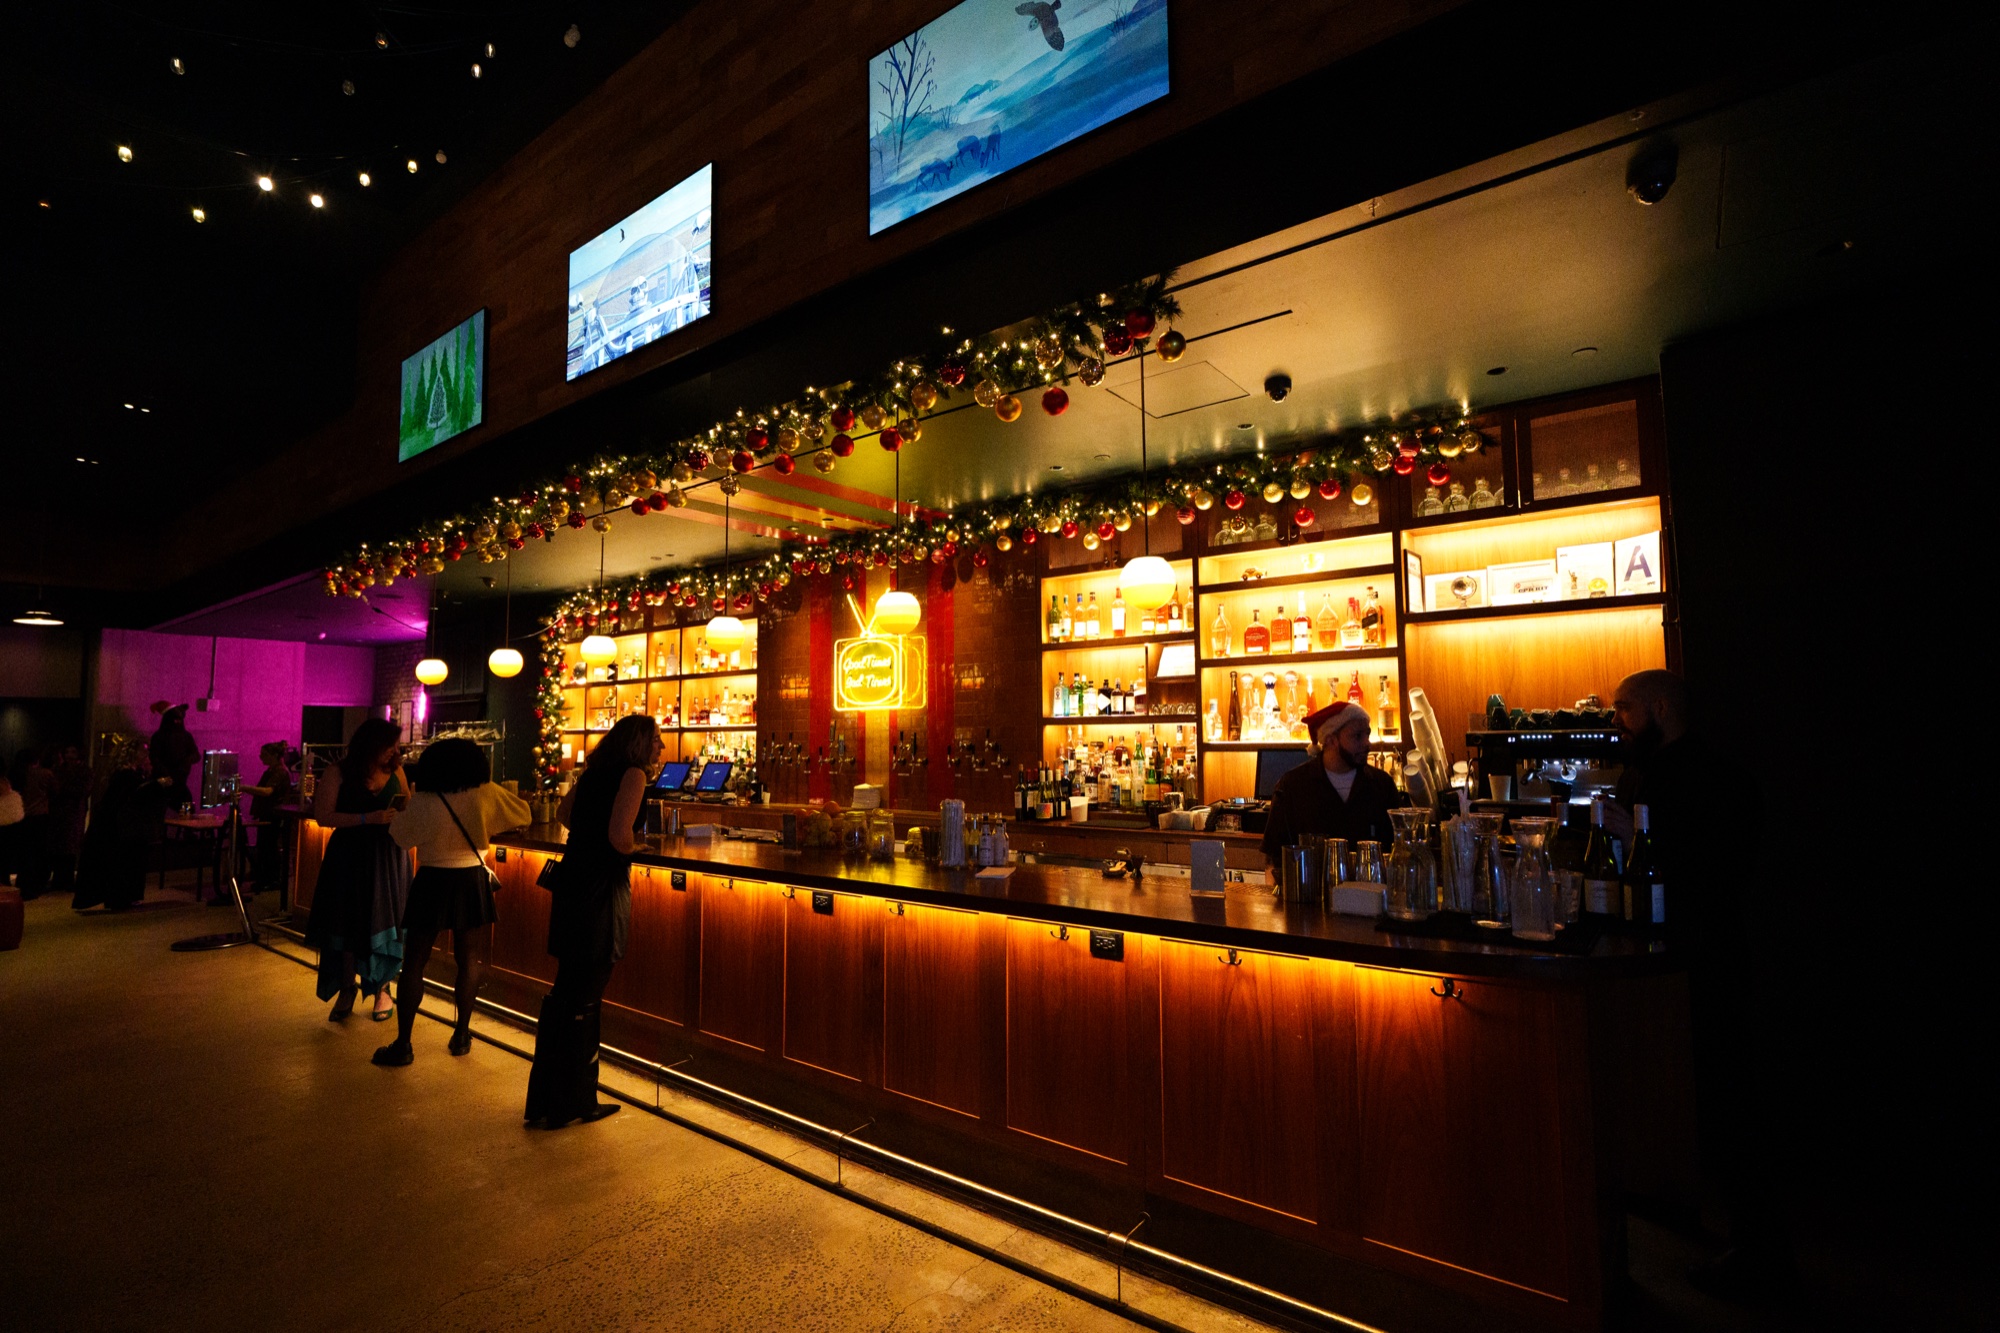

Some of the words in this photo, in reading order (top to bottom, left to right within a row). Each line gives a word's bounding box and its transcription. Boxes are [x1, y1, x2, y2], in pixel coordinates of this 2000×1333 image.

[1624, 545, 1652, 582] A
[843, 656, 866, 674] Good
[866, 654, 892, 668] Times
[866, 674, 892, 688] Times
